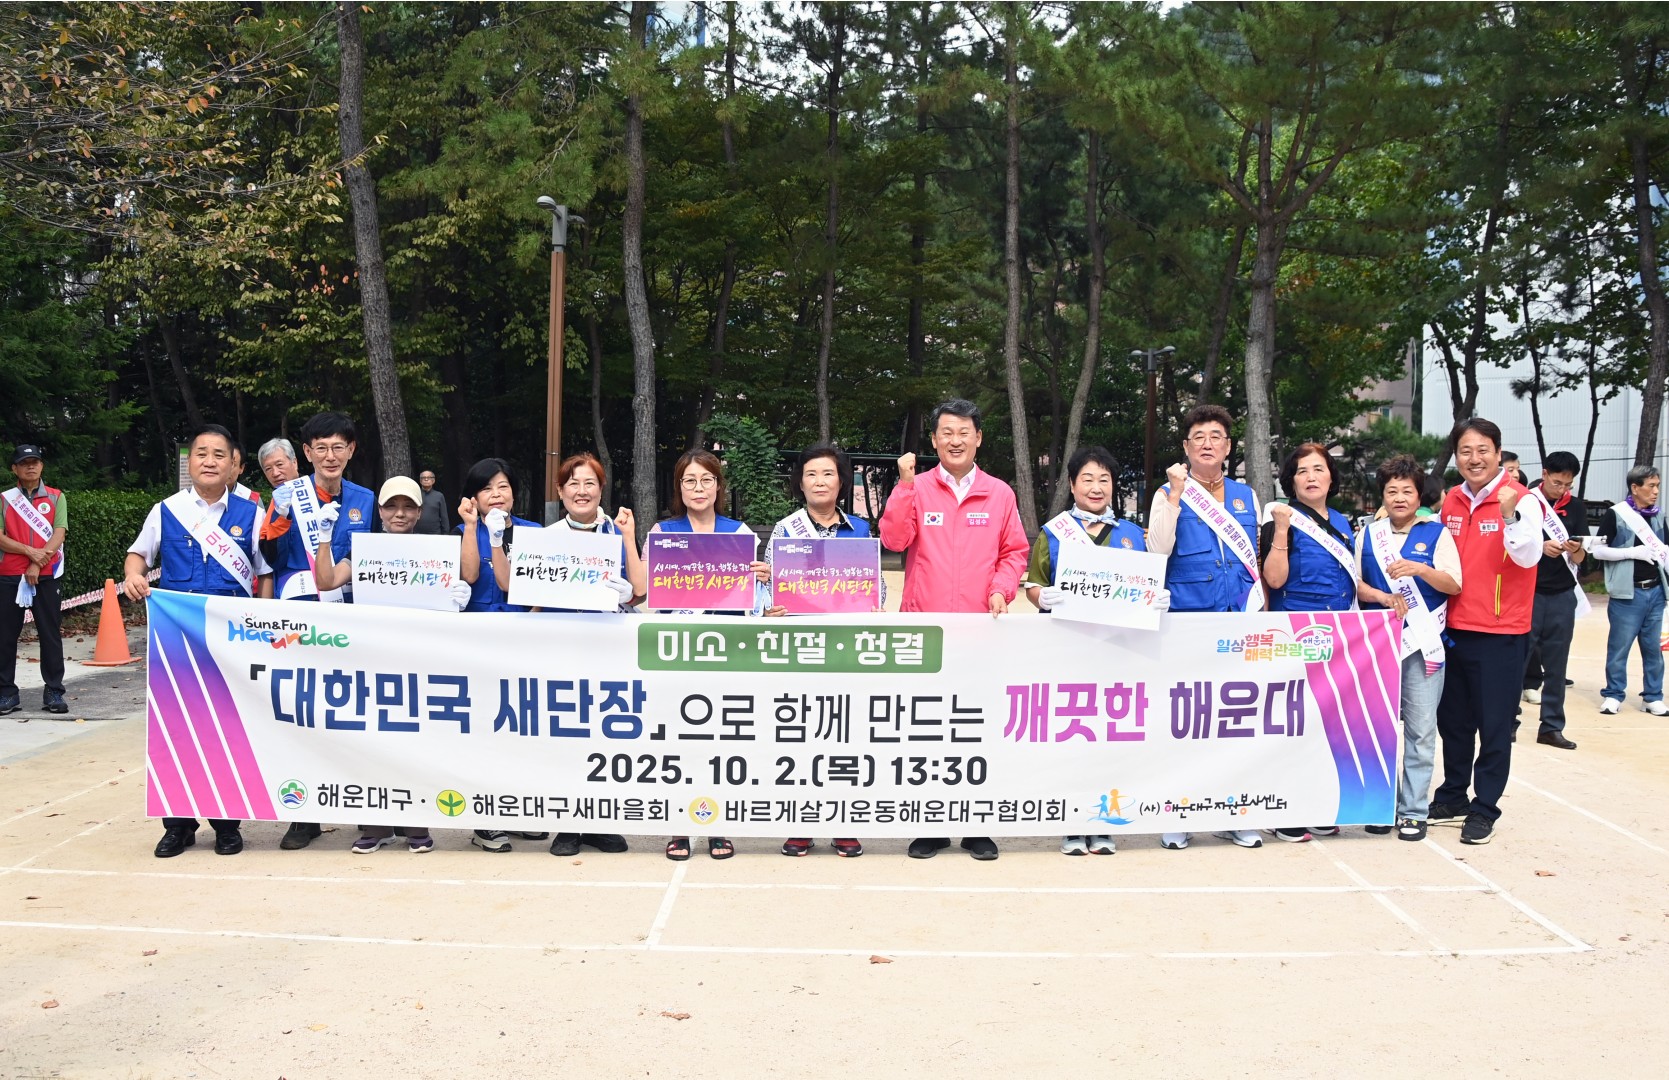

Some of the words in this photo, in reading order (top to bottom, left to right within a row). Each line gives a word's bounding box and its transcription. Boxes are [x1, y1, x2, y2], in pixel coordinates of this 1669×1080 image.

[358, 567, 408, 586] 대한민국
[410, 571, 453, 588] 새단장
[515, 562, 569, 582] 대한민국
[653, 571, 705, 590] 대한민국
[705, 573, 749, 592] 새단장
[777, 576, 829, 595] 대한민국
[830, 578, 874, 596] 새단장
[1060, 578, 1112, 599] 대한민국
[1112, 585, 1156, 606] 새단장
[227, 619, 350, 649] Haeundae
[245, 616, 308, 631] Sun&Fun
[1302, 634, 1332, 646] 해운대
[773, 692, 851, 744] 함께
[868, 693, 985, 744] 만드는
[1003, 681, 1149, 743] 깨끗한
[1169, 678, 1306, 740] 해운대
[586, 753, 693, 785] 2025.
[708, 755, 760, 786] 10.
[890, 755, 988, 786] 13:30
[1139, 801, 1161, 816] (사)
